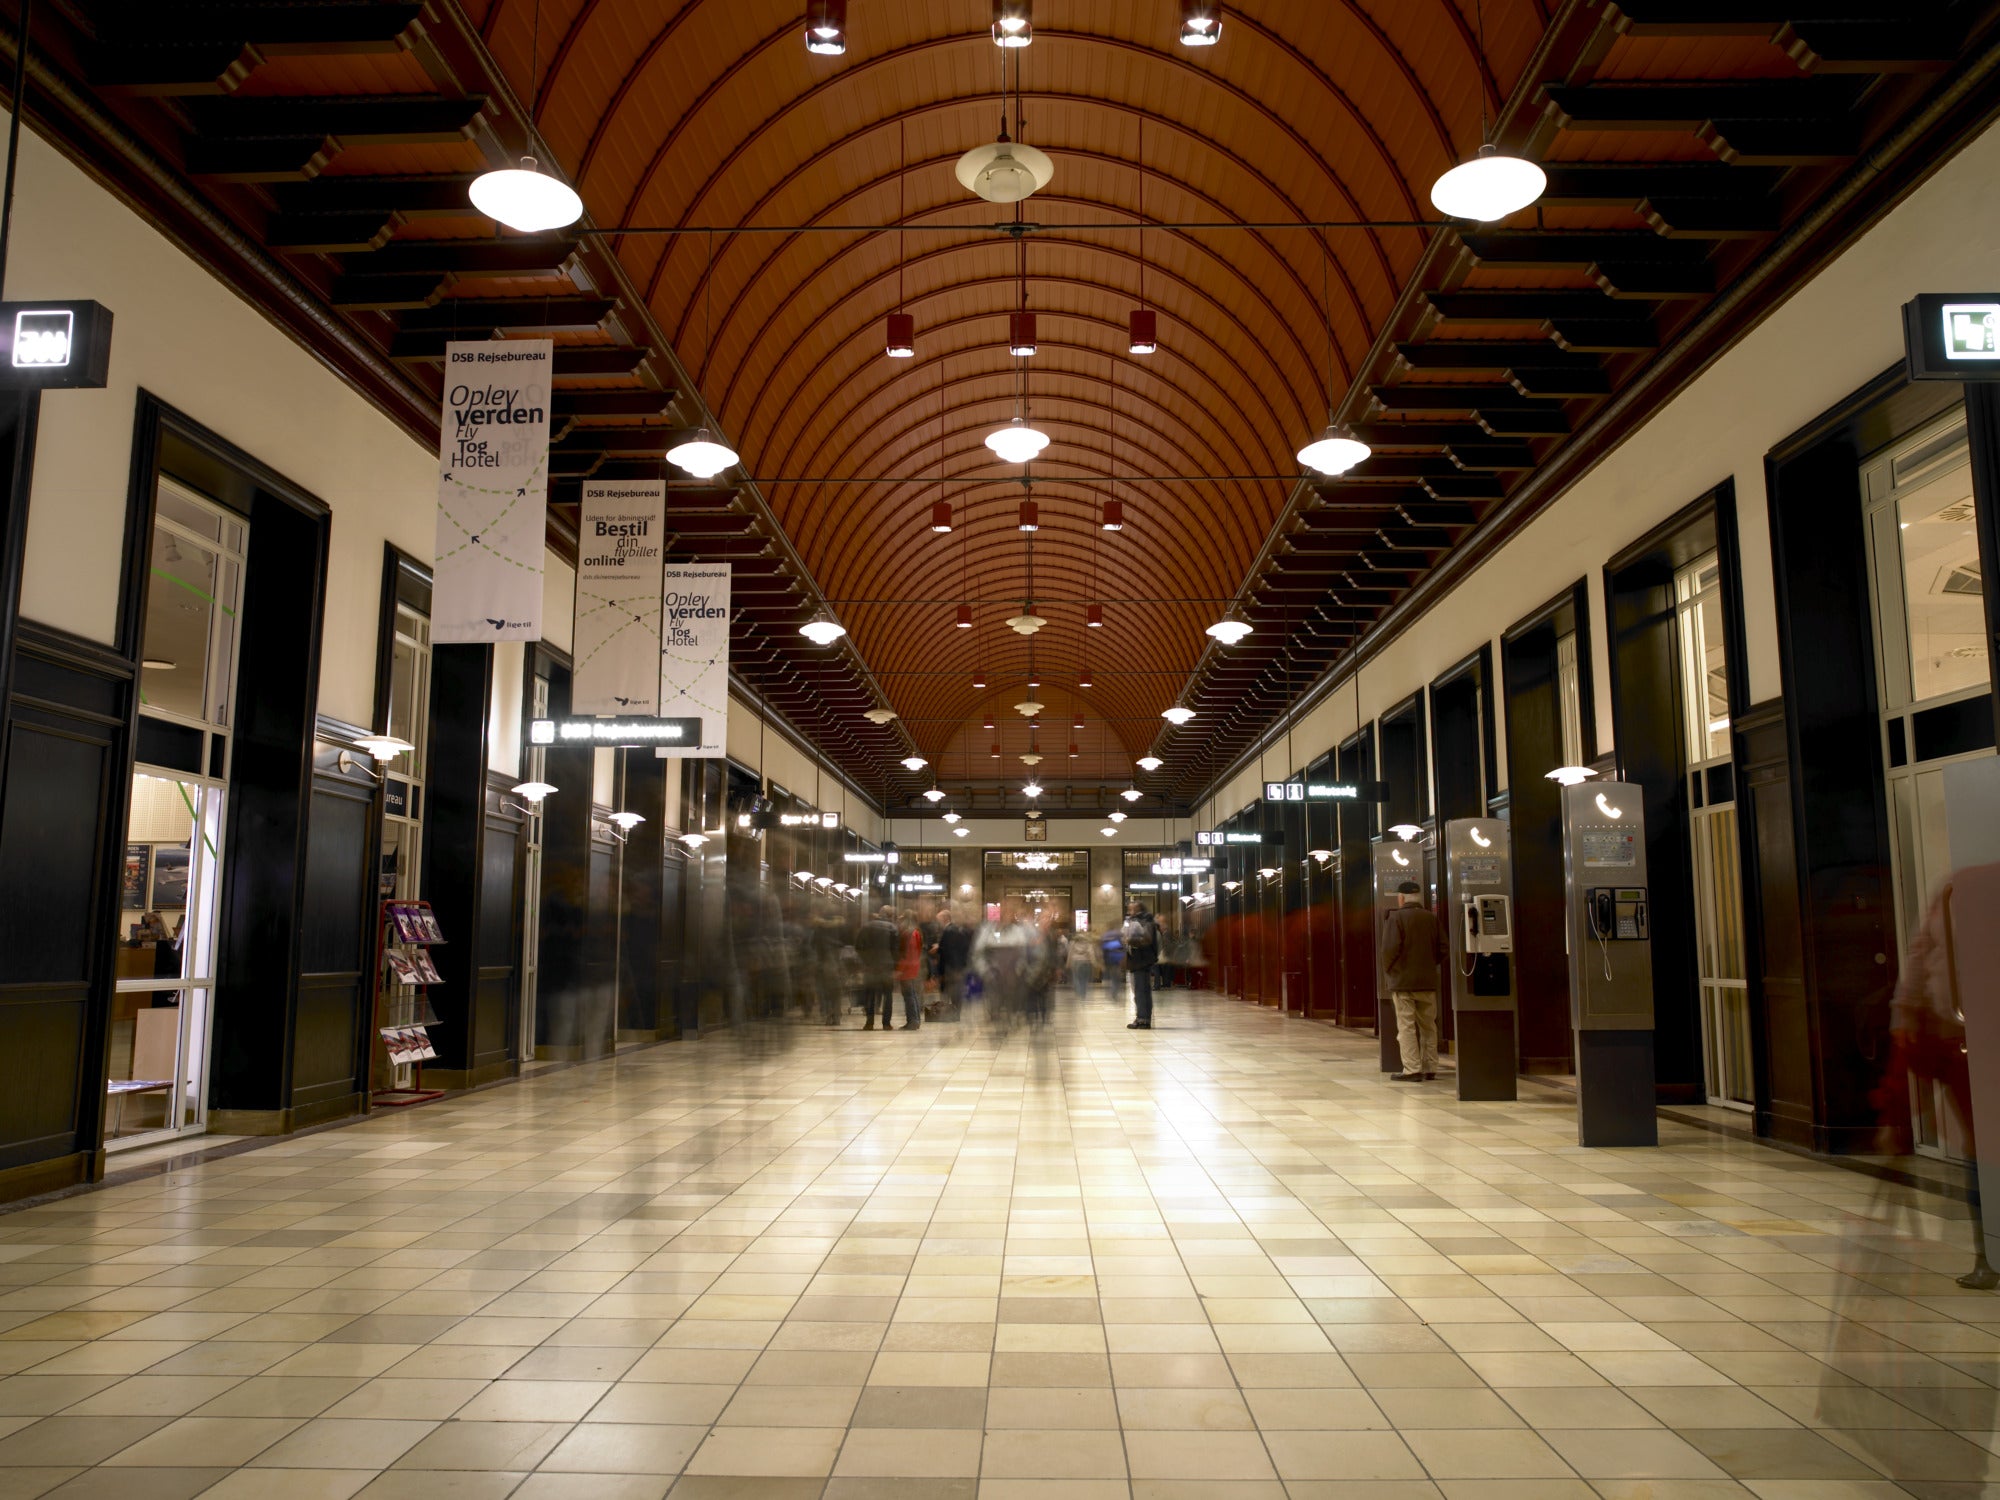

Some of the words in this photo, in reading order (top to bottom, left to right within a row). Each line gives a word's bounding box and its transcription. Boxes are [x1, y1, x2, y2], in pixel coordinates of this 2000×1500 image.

[452, 353, 474, 363] DSB
[477, 352, 546, 363] Rejsebureau
[449, 384, 519, 416] Oplev
[455, 406, 543, 426] verden
[456, 424, 479, 441] Fly
[457, 440, 487, 456] Tog
[452, 451, 500, 468] Hotel
[587, 490, 605, 498] DSB
[607, 489, 660, 499] Rejsebureau
[596, 521, 648, 536] Bestil
[617, 535, 638, 548] din
[614, 546, 658, 559] flybillet
[584, 554, 625, 567] online
[683, 570, 727, 579] Rejsebureau
[665, 592, 710, 614] Oplev
[669, 607, 726, 620] verden
[669, 618, 685, 629] Fly
[671, 628, 690, 639] Tog
[667, 635, 698, 647] Hotel
